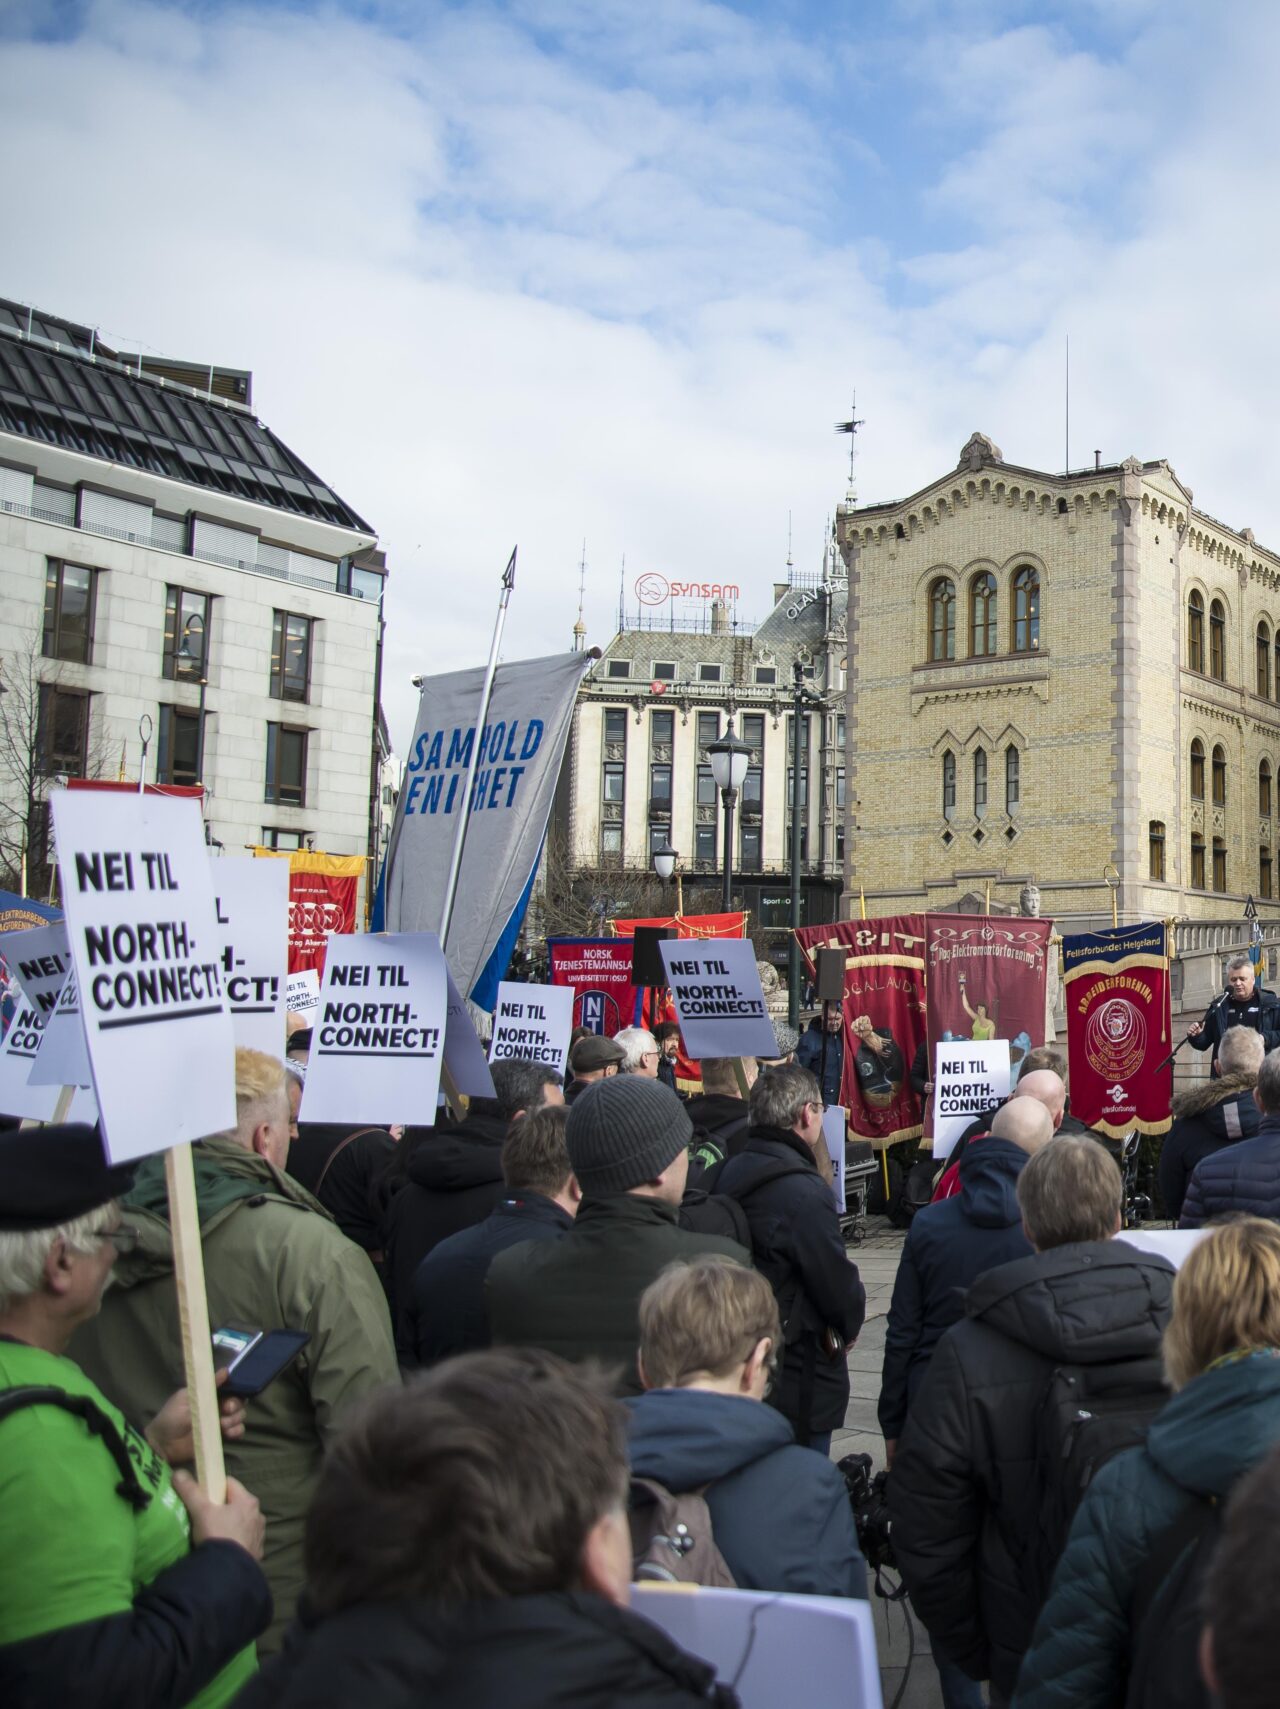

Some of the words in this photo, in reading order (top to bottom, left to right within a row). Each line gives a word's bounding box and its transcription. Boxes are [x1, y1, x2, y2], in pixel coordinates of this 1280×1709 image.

[670, 582, 740, 599] SYNSAM
[787, 587, 818, 619] OLAV
[819, 579, 848, 594] THO
[75, 852, 135, 892] NEI
[141, 852, 179, 890] TIL
[84, 921, 196, 967] NORTH-
[1066, 943, 1122, 958] Fellesforbundet
[1123, 937, 1161, 950] Helgeland
[583, 949, 613, 959] NORSK
[18, 954, 66, 981] NEI
[554, 960, 633, 971] TJENESTEMANNSLA
[669, 960, 700, 976] NEI
[703, 960, 730, 975] TIL
[297, 981, 307, 989] TIL
[329, 965, 371, 987] NEI
[377, 965, 410, 987] TIL
[567, 974, 609, 983] UNIVERSITETET
[612, 975, 627, 983] OSLO
[92, 963, 222, 1012] CONNECT!
[676, 984, 743, 1000] NORTH-
[843, 976, 912, 999] OGALAND
[323, 1002, 418, 1024] NORTH-
[500, 1002, 523, 1018] NEI
[527, 1004, 546, 1020] TIL
[680, 1000, 764, 1014] CONNECT!
[319, 1026, 440, 1049] CONNECT!
[497, 1027, 551, 1045] NORTH-
[494, 1043, 562, 1062] CONNECT!
[941, 1061, 965, 1075] NEI
[968, 1060, 988, 1073] TIL
[940, 1083, 994, 1097] NORTH-
